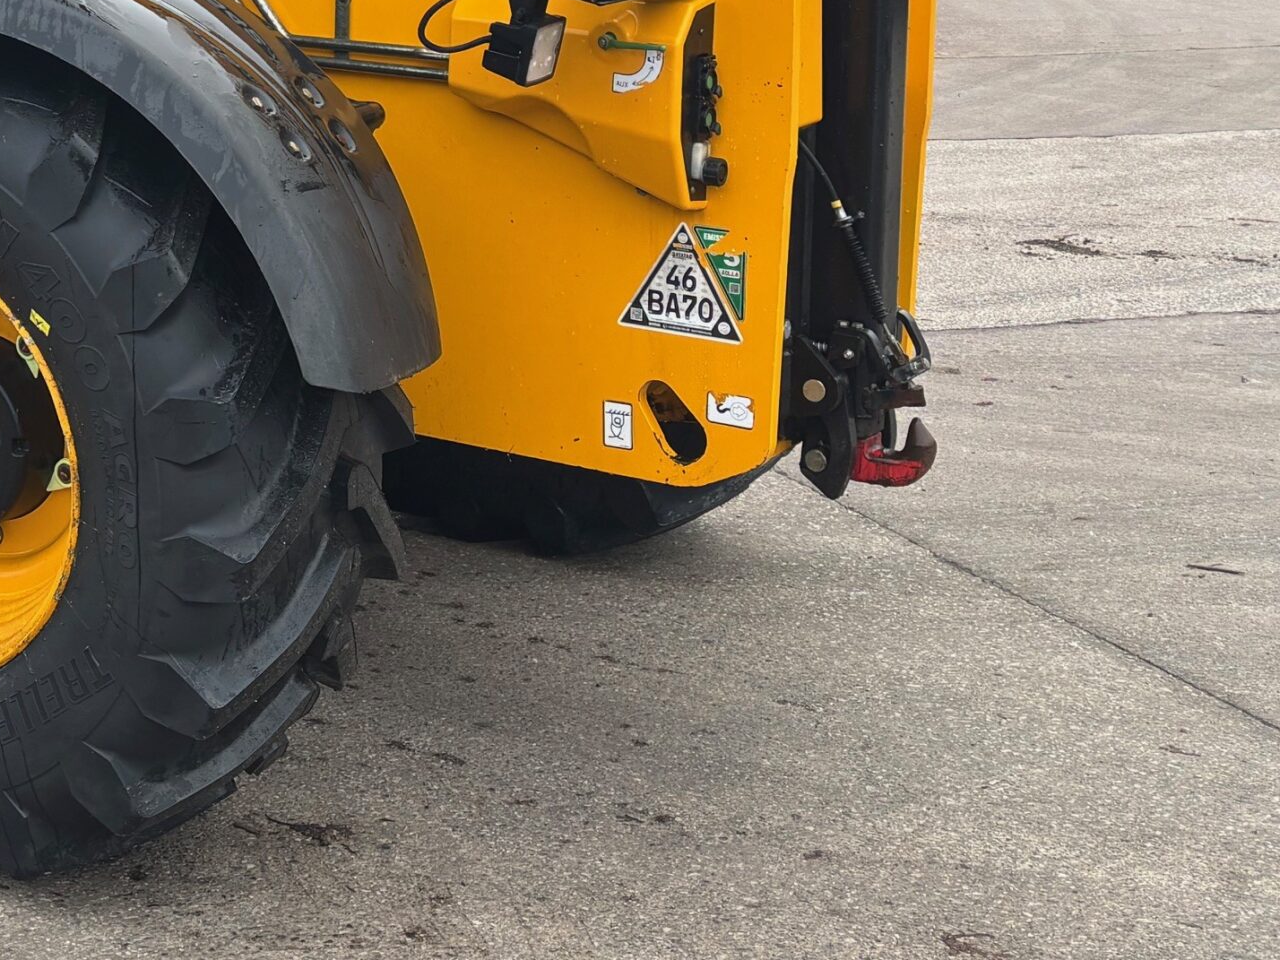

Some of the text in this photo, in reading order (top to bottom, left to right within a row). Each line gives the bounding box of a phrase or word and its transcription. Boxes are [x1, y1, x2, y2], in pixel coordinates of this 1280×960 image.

[666, 265, 697, 292] 46
[647, 289, 714, 323] BA70
[17, 261, 111, 391] 400
